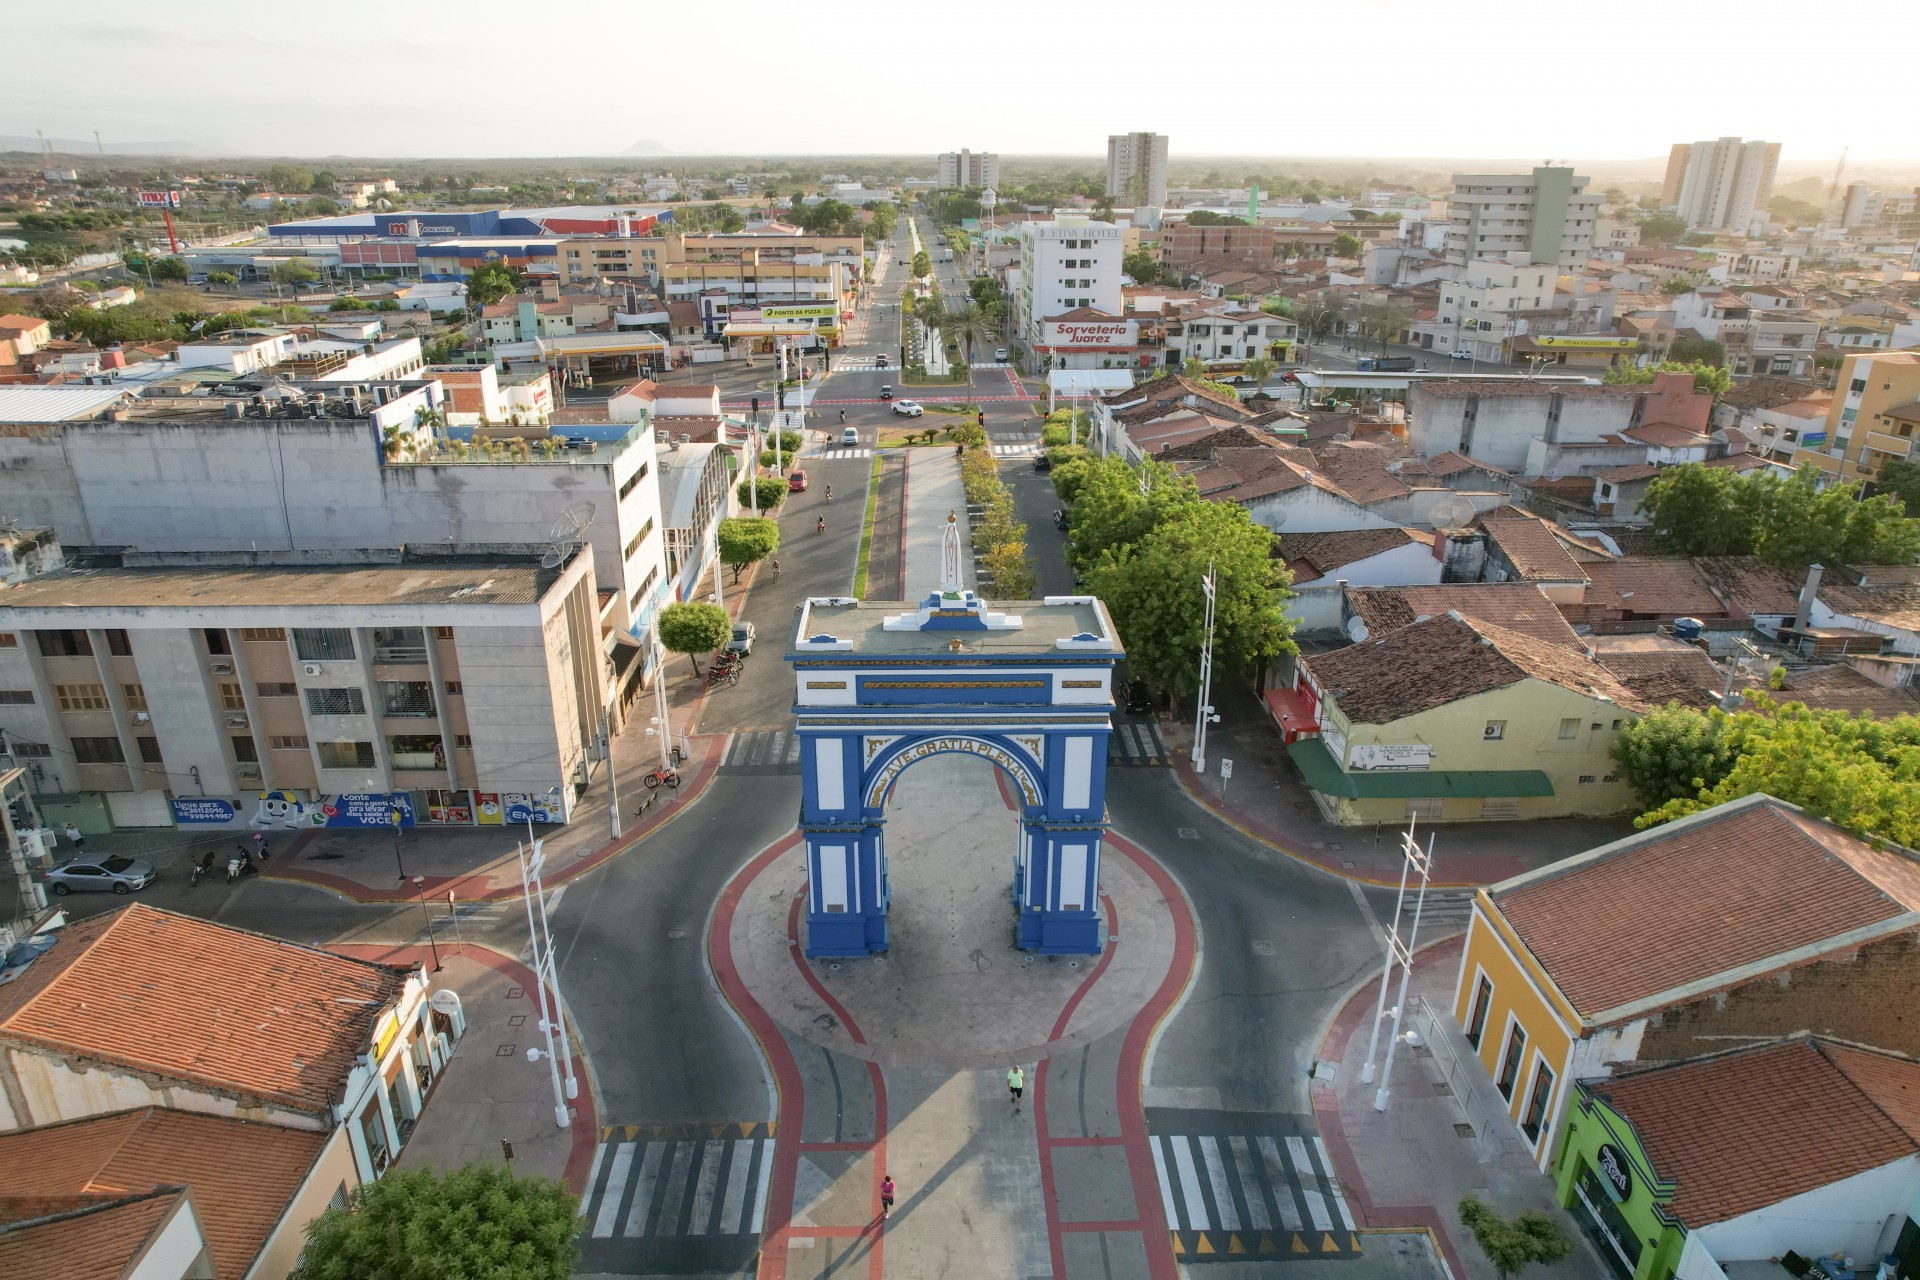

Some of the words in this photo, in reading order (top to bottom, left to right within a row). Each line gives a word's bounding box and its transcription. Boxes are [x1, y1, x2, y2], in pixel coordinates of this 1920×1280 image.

[1083, 229, 1122, 238] HOTEL
[1056, 323, 1127, 335] Sorveteria
[1069, 332, 1111, 343] Juarez
[885, 749, 917, 779] AVE,
[916, 738, 974, 756] GRATIA
[342, 793, 370, 801] Conte
[174, 801, 199, 811] Ligue
[198, 801, 220, 809] para:
[512, 811, 544, 822] EMS
